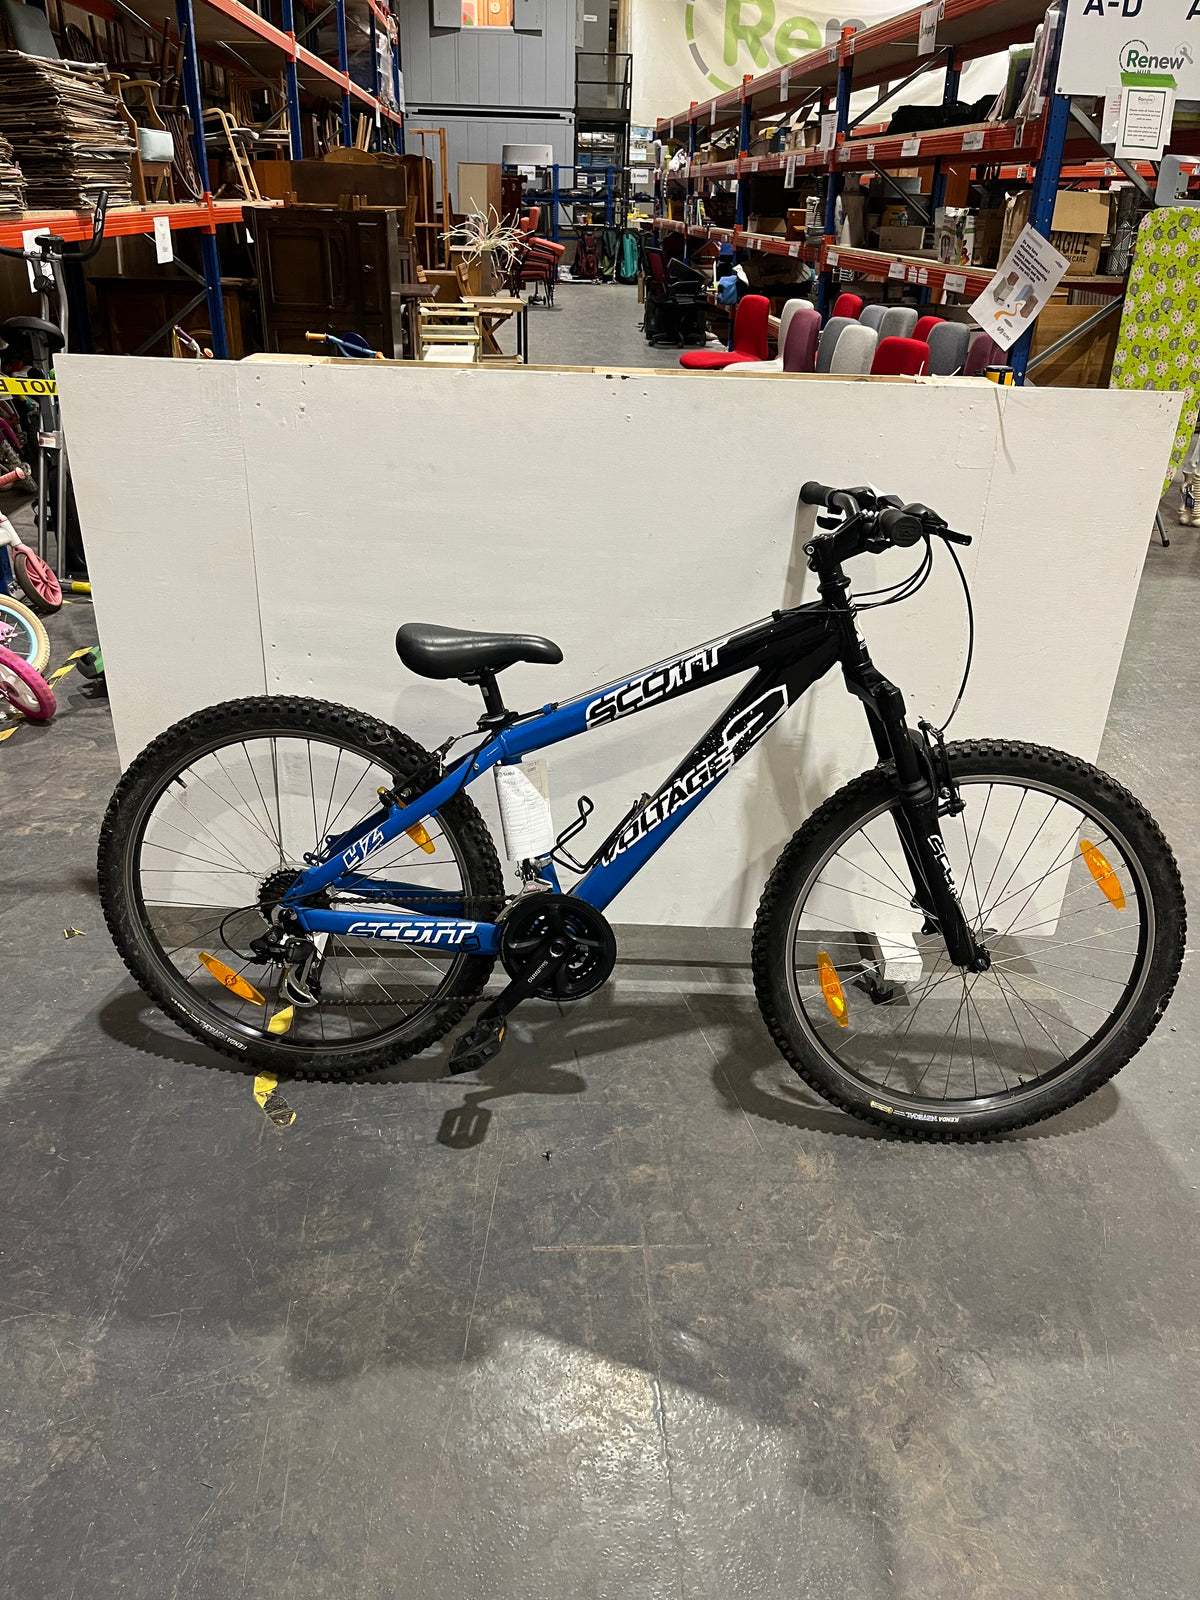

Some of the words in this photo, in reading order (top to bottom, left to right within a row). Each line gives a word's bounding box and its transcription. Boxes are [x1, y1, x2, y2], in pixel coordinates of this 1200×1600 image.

[1083, 0, 1143, 17] A-D
[1126, 50, 1185, 69] Renew
[586, 638, 728, 731] SCOTT
[602, 750, 735, 867] VOLTAGE
[346, 922, 478, 944] SCOTT
[227, 1037, 247, 1051] KENDA
